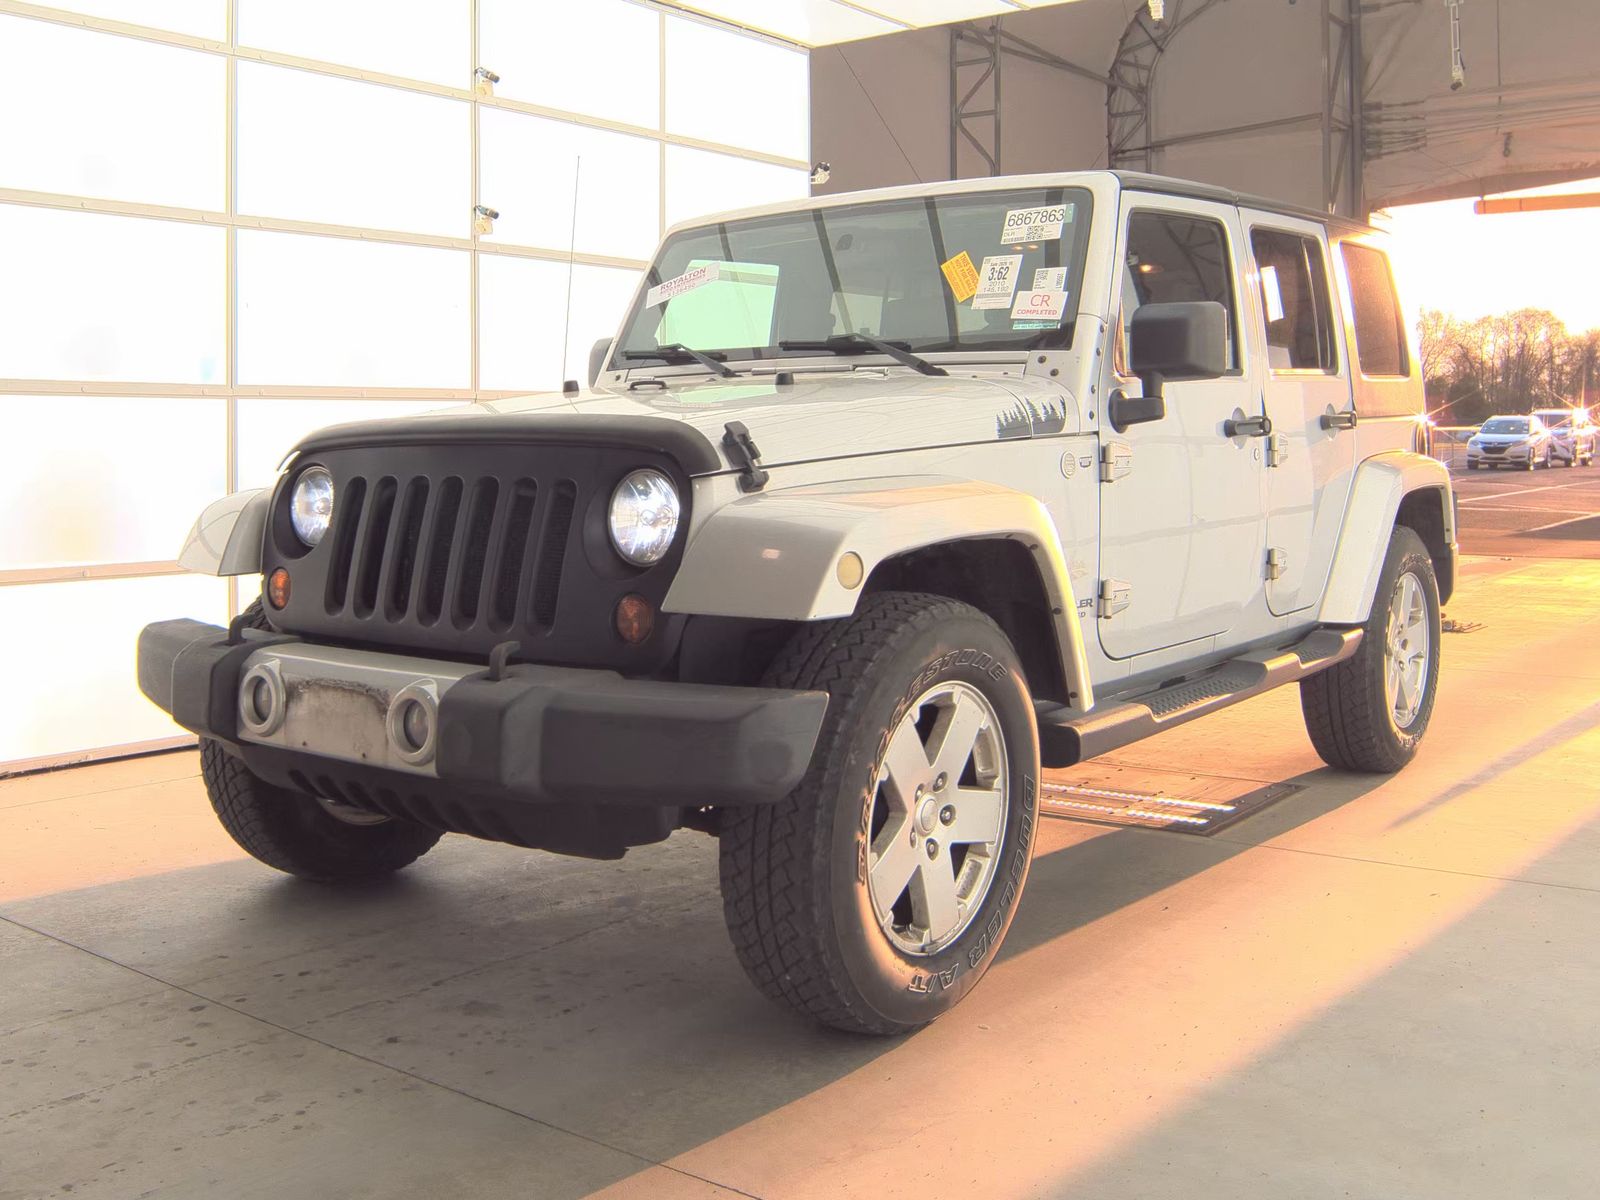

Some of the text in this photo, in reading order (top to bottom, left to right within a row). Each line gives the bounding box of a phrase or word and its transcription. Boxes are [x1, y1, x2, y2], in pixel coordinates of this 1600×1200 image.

[1007, 208, 1065, 227] 6867863
[660, 267, 706, 290] ROYALTON
[988, 266, 1009, 281] 3:62
[1030, 294, 1051, 307] CR
[908, 774, 1035, 993] DUELER A/T
